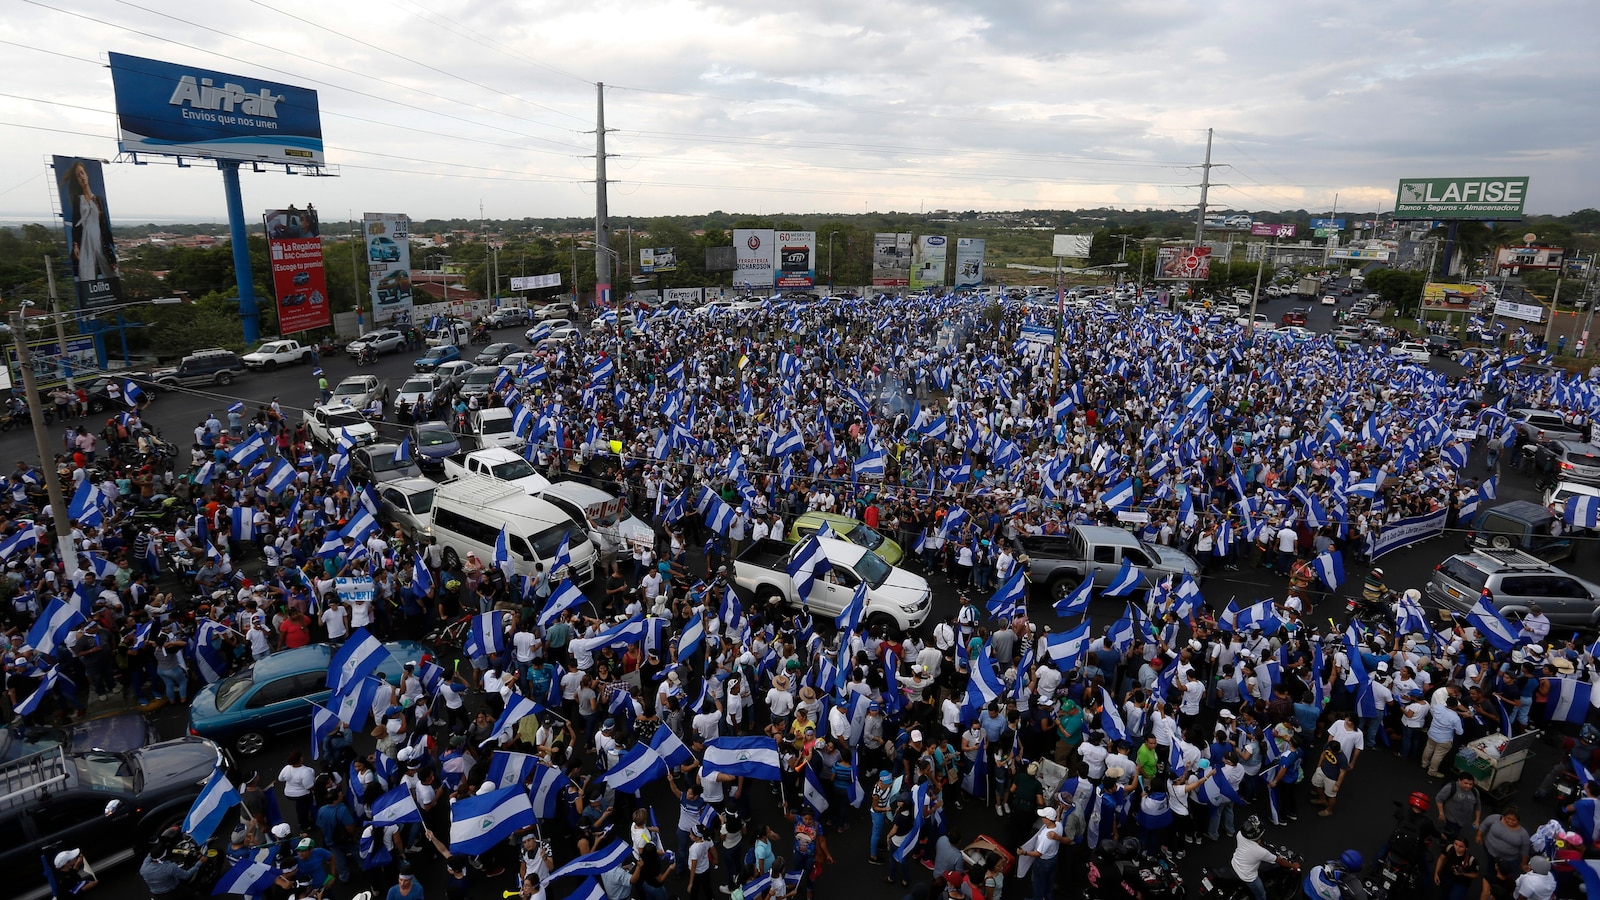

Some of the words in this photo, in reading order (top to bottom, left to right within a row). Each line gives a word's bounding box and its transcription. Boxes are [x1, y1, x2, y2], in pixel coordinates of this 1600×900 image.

[218, 115, 236, 125] que
[238, 117, 254, 126] nos
[256, 120, 278, 129] unen
[1425, 182, 1524, 202] LAFISE
[780, 233, 790, 241] 60
[283, 243, 292, 251] La
[292, 242, 320, 252] Regalona
[295, 251, 322, 259] Credomatic
[304, 261, 323, 270] premio!
[89, 282, 110, 293] Lolita
